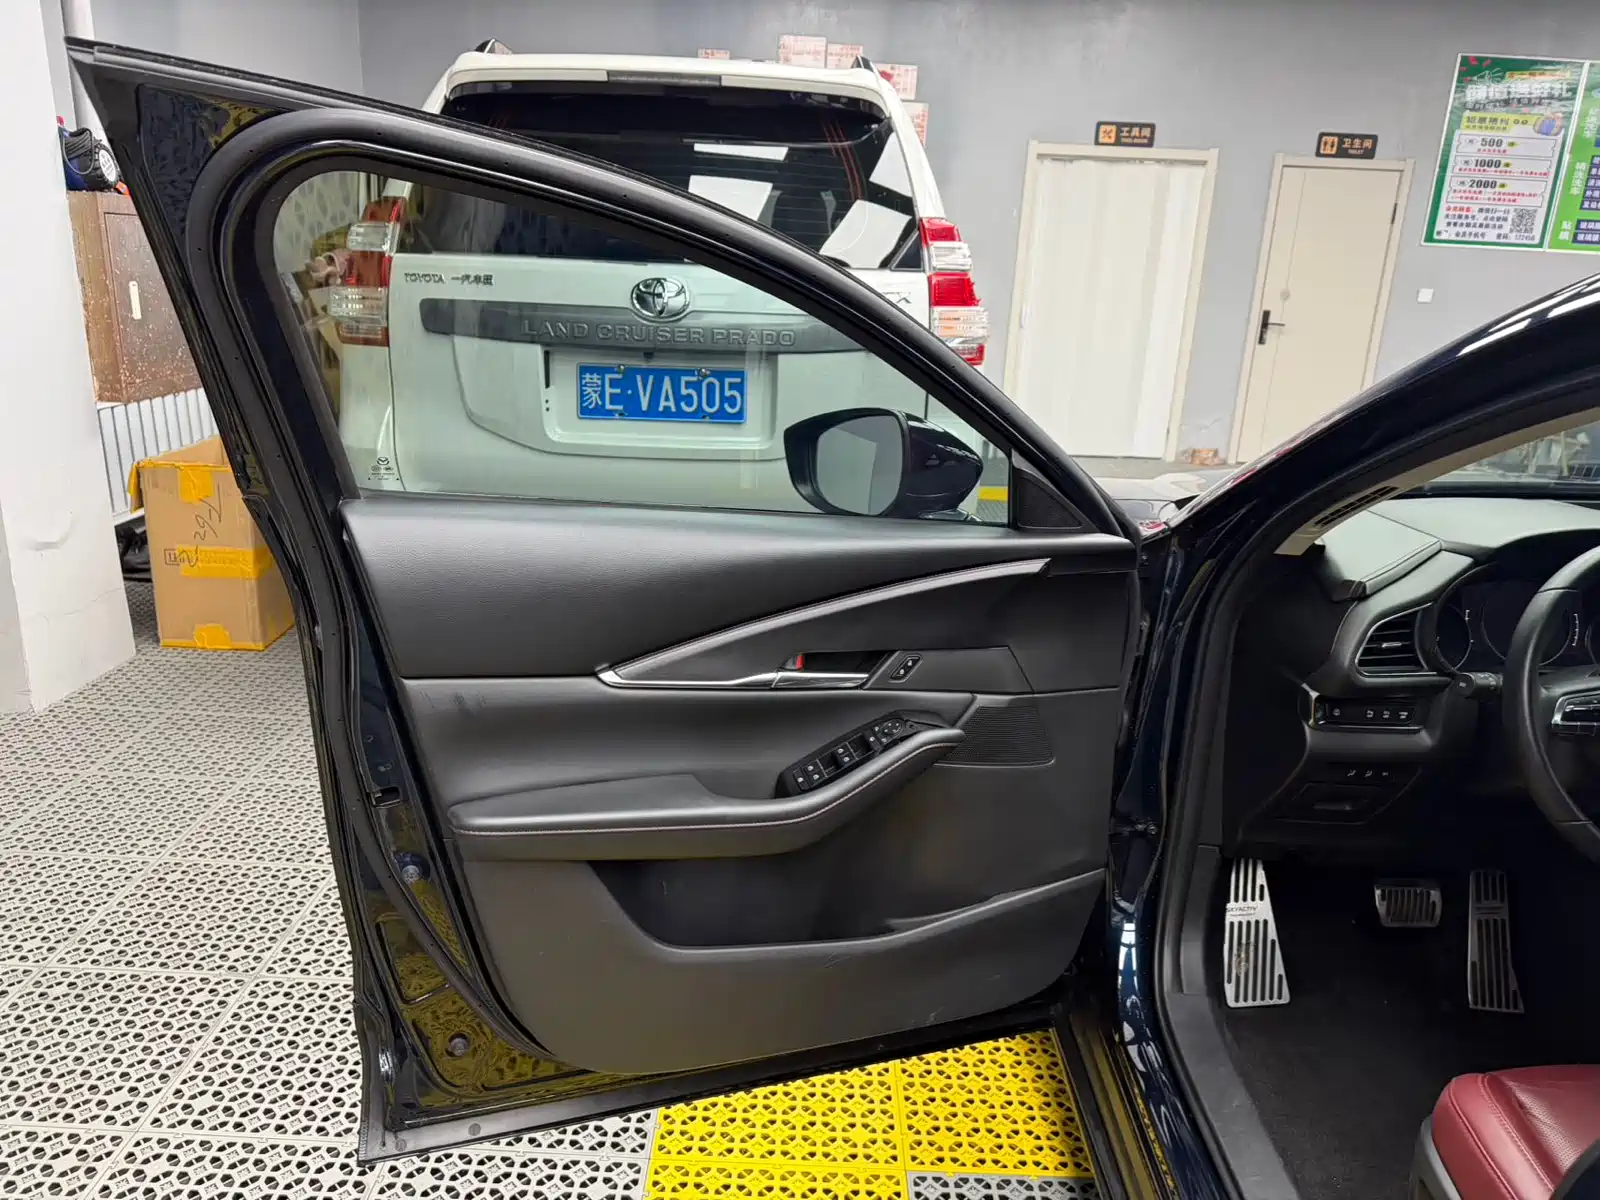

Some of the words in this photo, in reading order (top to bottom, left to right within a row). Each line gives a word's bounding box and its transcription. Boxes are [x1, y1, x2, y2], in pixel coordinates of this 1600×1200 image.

[1120, 127, 1152, 138] 工具间
[1342, 138, 1373, 149] 卫生间
[1481, 137, 1504, 148] 500
[1474, 158, 1502, 169] 1000
[1469, 179, 1498, 189] 2000
[404, 272, 445, 284] TOYOTA
[522, 318, 589, 338] LAND
[596, 323, 705, 343] CRUISER
[711, 327, 797, 346] PRADO
